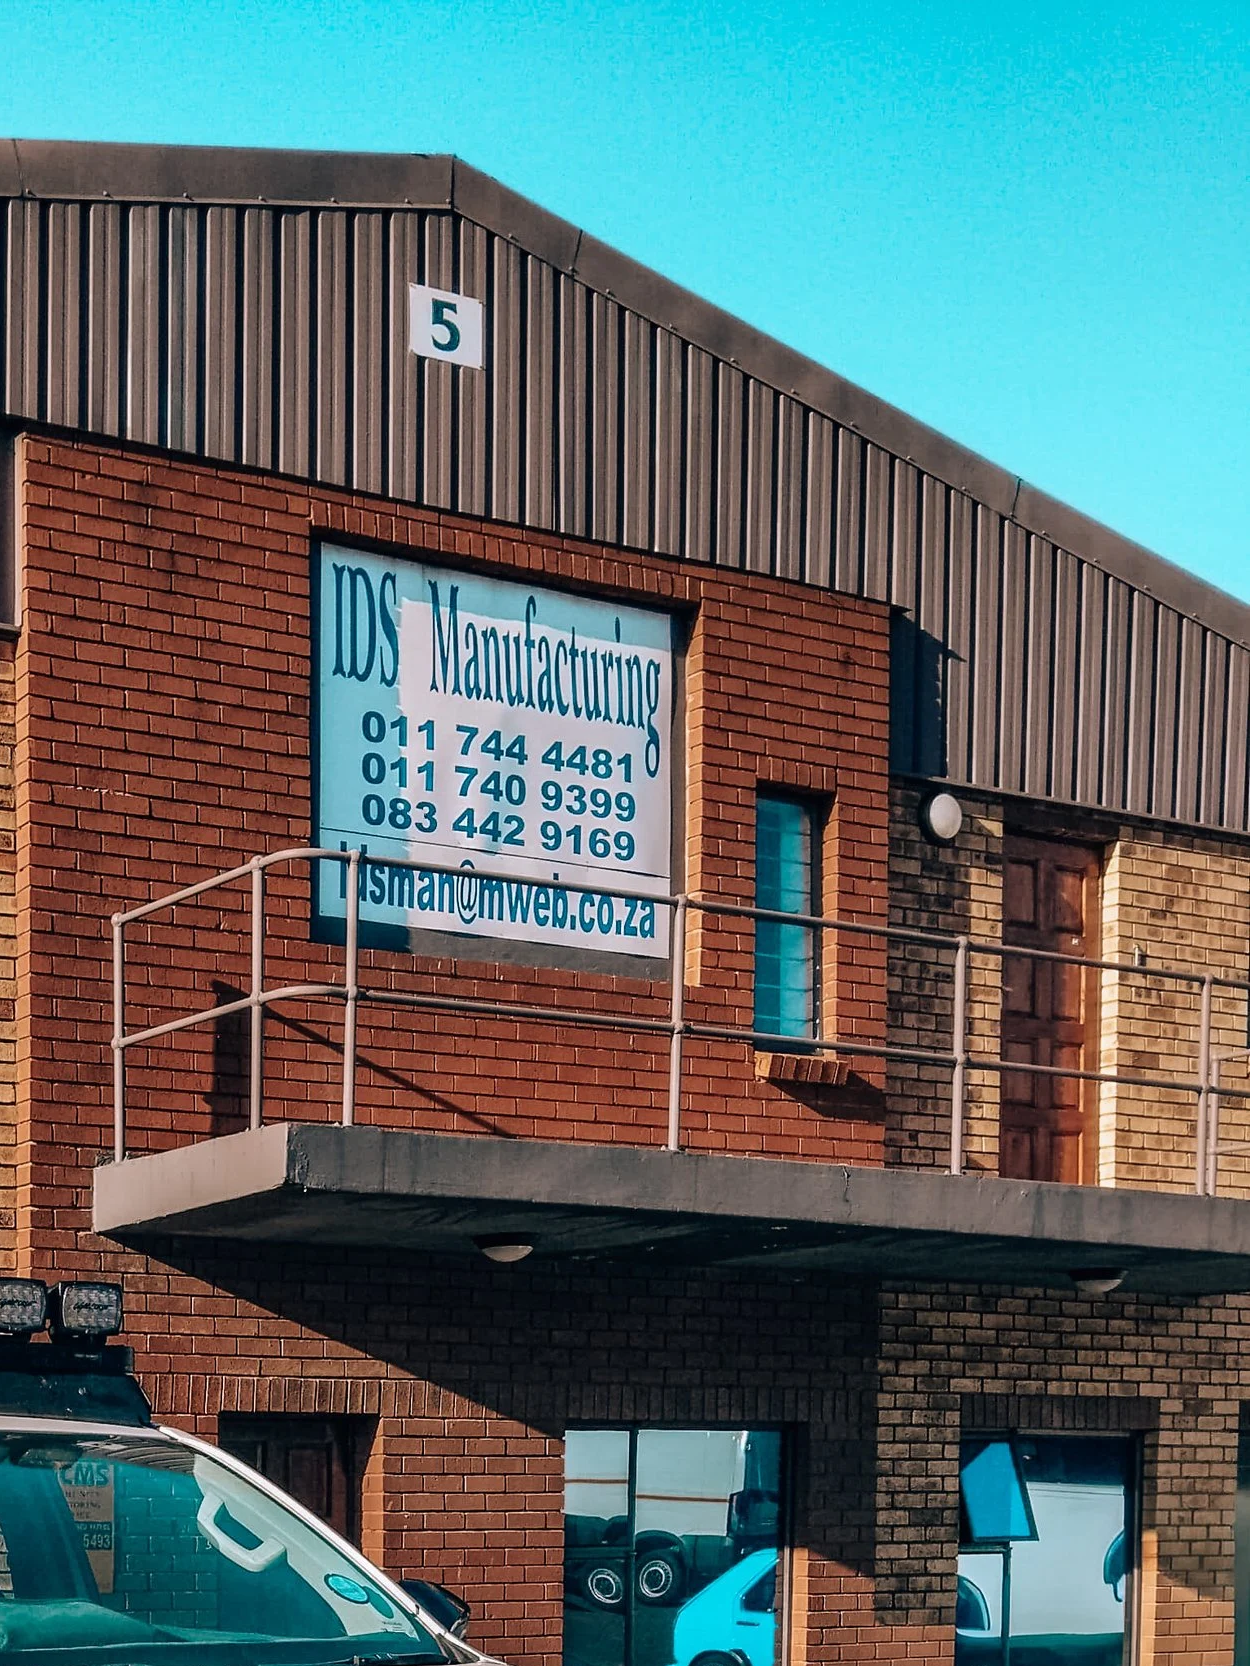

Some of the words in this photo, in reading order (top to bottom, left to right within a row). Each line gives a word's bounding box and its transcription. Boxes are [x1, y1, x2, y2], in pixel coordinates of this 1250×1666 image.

[430, 299, 461, 353] 5
[332, 562, 399, 688] IDS
[428, 580, 661, 778] Manufacturing
[362, 711, 435, 751] 011
[455, 724, 528, 766] 744
[541, 741, 633, 783] 4481
[362, 752, 435, 793] 011
[454, 765, 527, 807] 740
[541, 781, 636, 823] 9399
[362, 793, 438, 834] 083
[452, 807, 525, 848] 442
[541, 820, 636, 862] 9169
